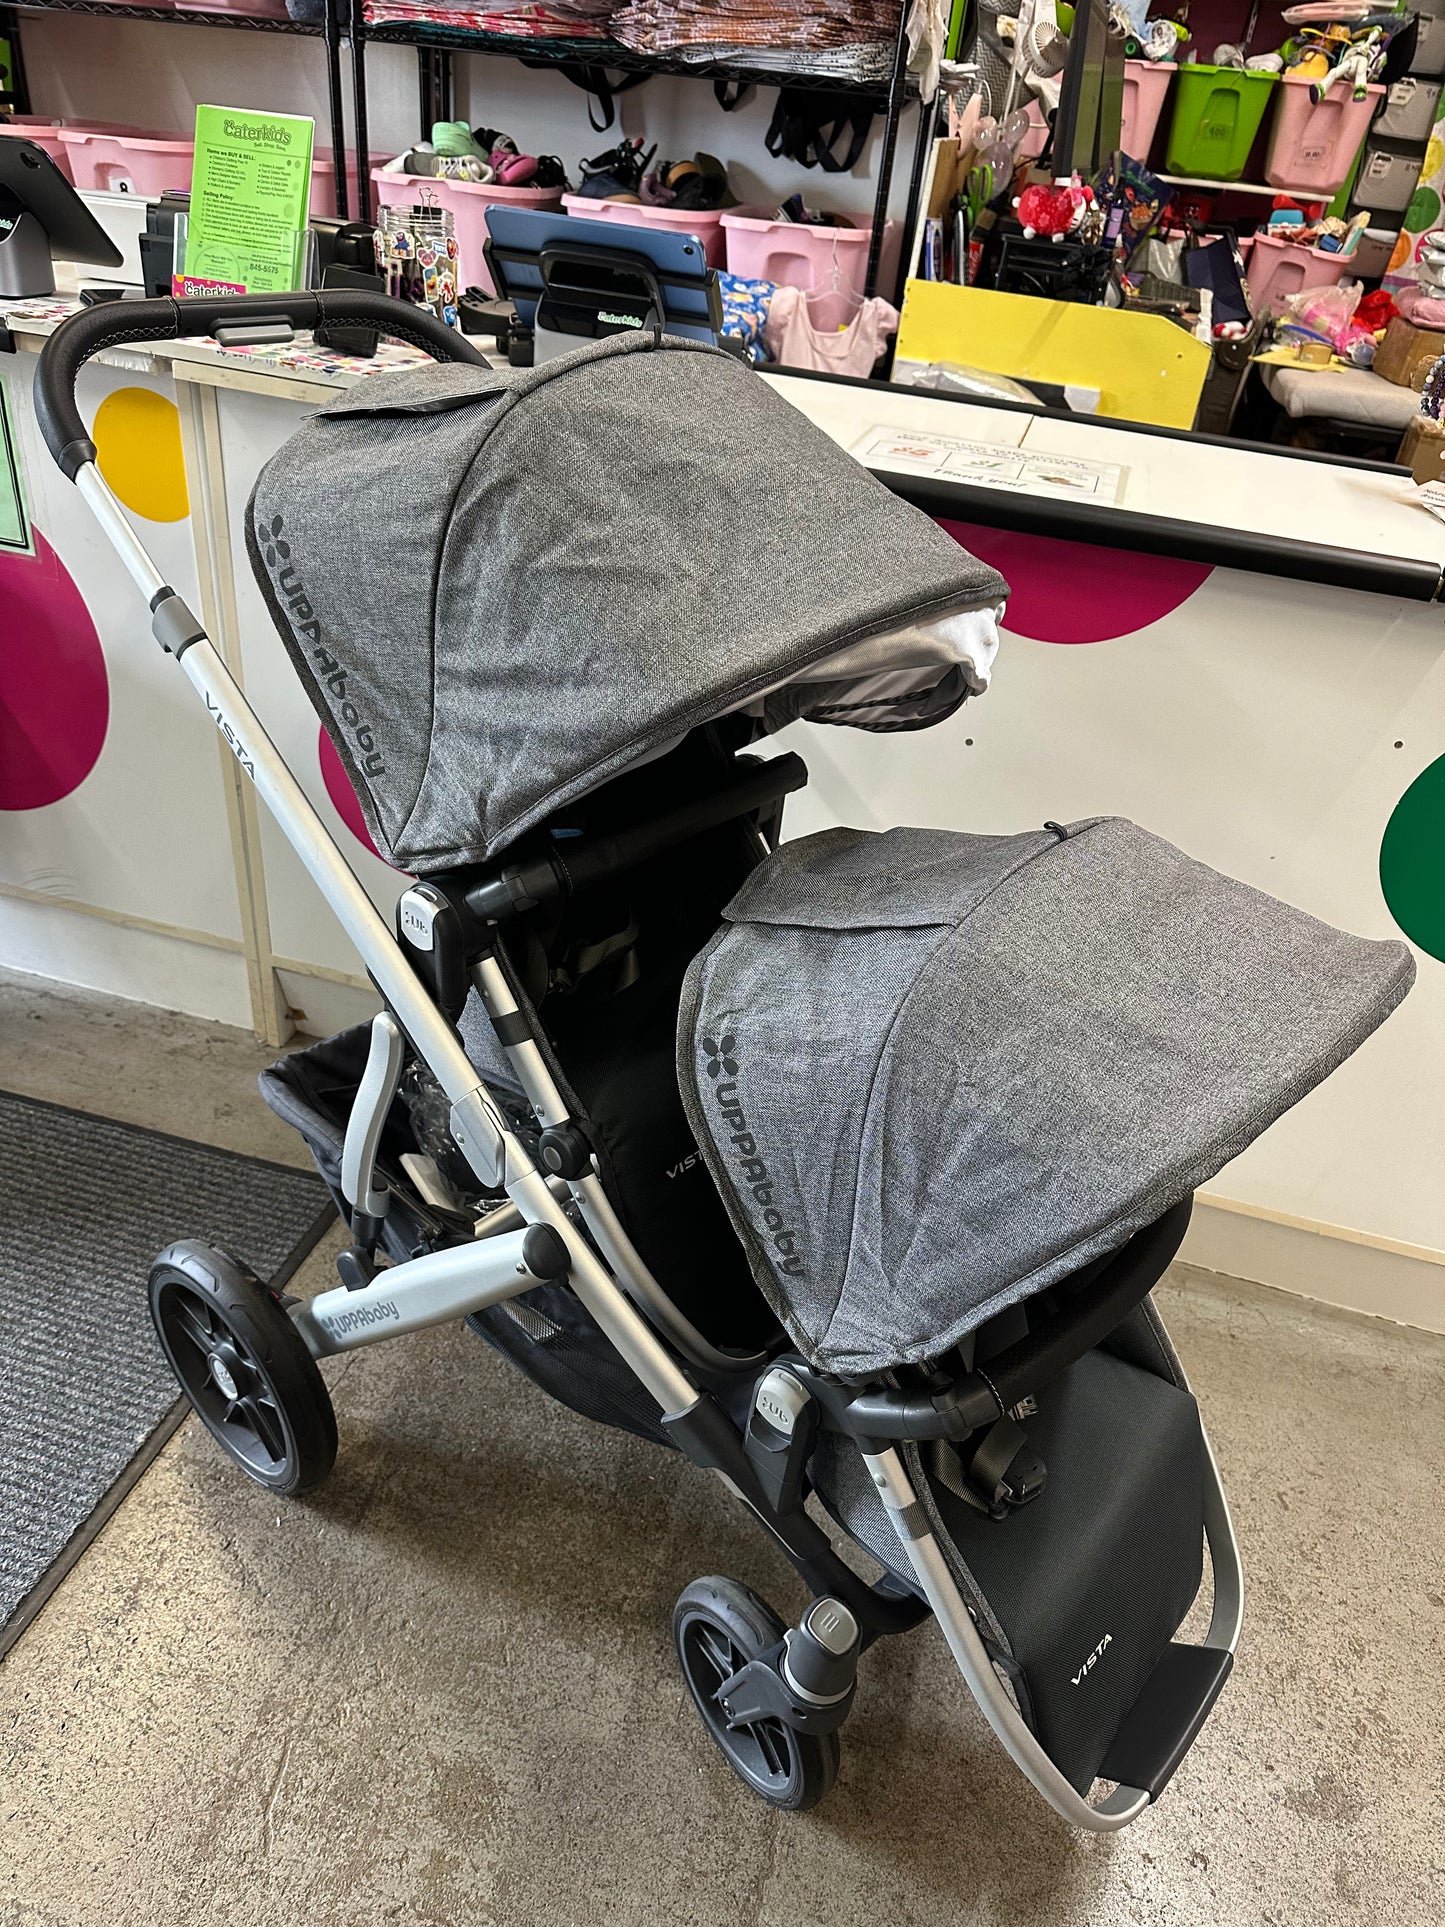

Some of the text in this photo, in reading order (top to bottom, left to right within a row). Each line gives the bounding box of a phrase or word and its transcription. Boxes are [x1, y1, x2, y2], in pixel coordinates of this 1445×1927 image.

[224, 119, 292, 146] Caterkids
[228, 151, 239, 159] BUY
[249, 263, 279, 274] 845-5575
[184, 281, 242, 296] Caterkid
[278, 566, 386, 779] UPPAbaby
[205, 690, 258, 782] VISTA
[716, 1081, 807, 1277] UPPAbaby
[334, 1300, 400, 1333] UPPAbaby
[1070, 1633, 1113, 1686] VISTA
